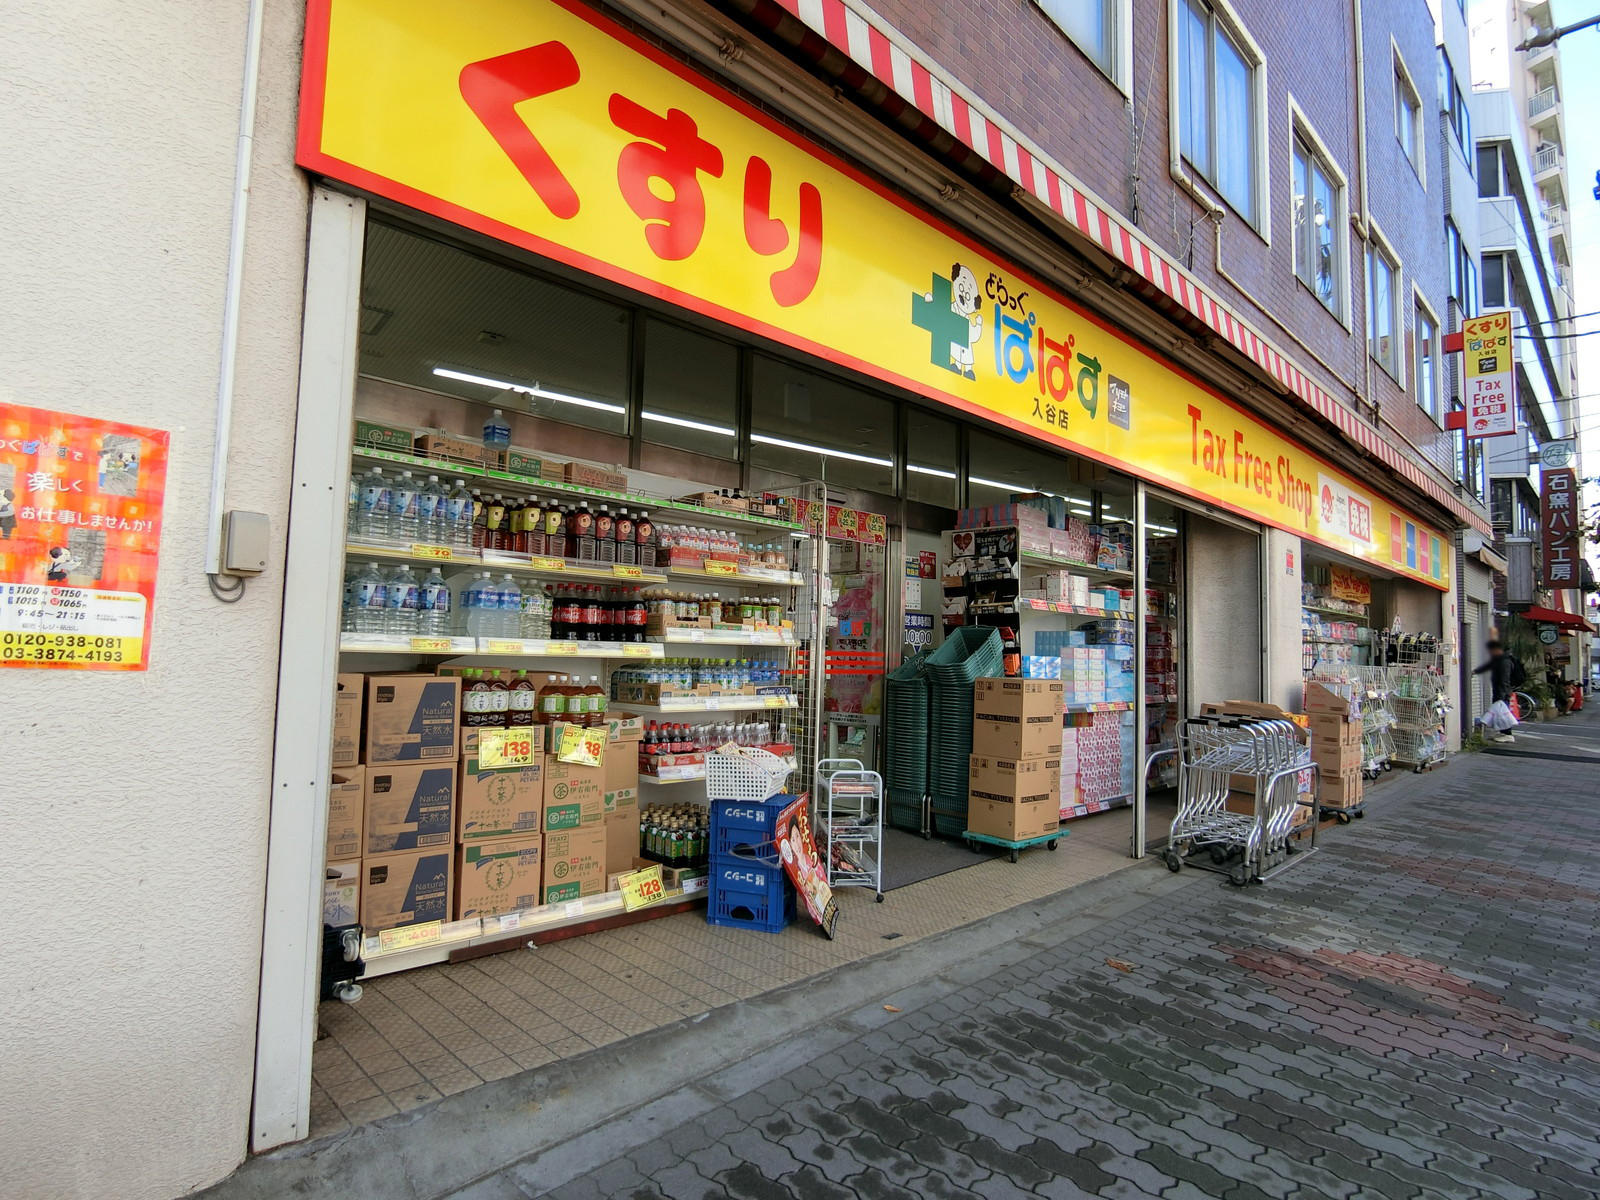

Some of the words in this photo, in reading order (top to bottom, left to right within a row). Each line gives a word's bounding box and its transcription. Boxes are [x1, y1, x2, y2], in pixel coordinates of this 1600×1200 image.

[458, 40, 823, 308] くすり
[985, 272, 1029, 316] どらっぐ
[1466, 316, 1508, 336] くすり
[1469, 336, 1508, 351] ぱぱす
[994, 303, 1102, 420] ぱぱす
[1476, 379, 1501, 392] Tax
[1473, 393, 1505, 406] Free
[1032, 397, 1069, 430] 入谷店
[1477, 404, 1502, 416] 免税
[1188, 403, 1227, 478] Tax
[1234, 429, 1272, 499] Free
[1277, 455, 1313, 527] Shop
[27, 471, 84, 493] 楽しく
[21, 506, 153, 532] お仕事しませんか!
[1349, 501, 1370, 539] 免税
[1548, 474, 1571, 581] 石窯パン工房
[3, 633, 123, 649] 0120-938-081
[3, 647, 123, 662] 03-3874-4193
[422, 707, 453, 715] Natural
[422, 725, 453, 736] 天然水
[503, 740, 531, 757] 138
[570, 784, 598, 794] 伊右衛門
[419, 793, 450, 803] Natural
[419, 811, 450, 823] 天然水
[570, 860, 599, 872] 伊右衛門
[415, 879, 446, 891] Natural
[639, 879, 661, 897] 128
[415, 897, 446, 912] 天然水
